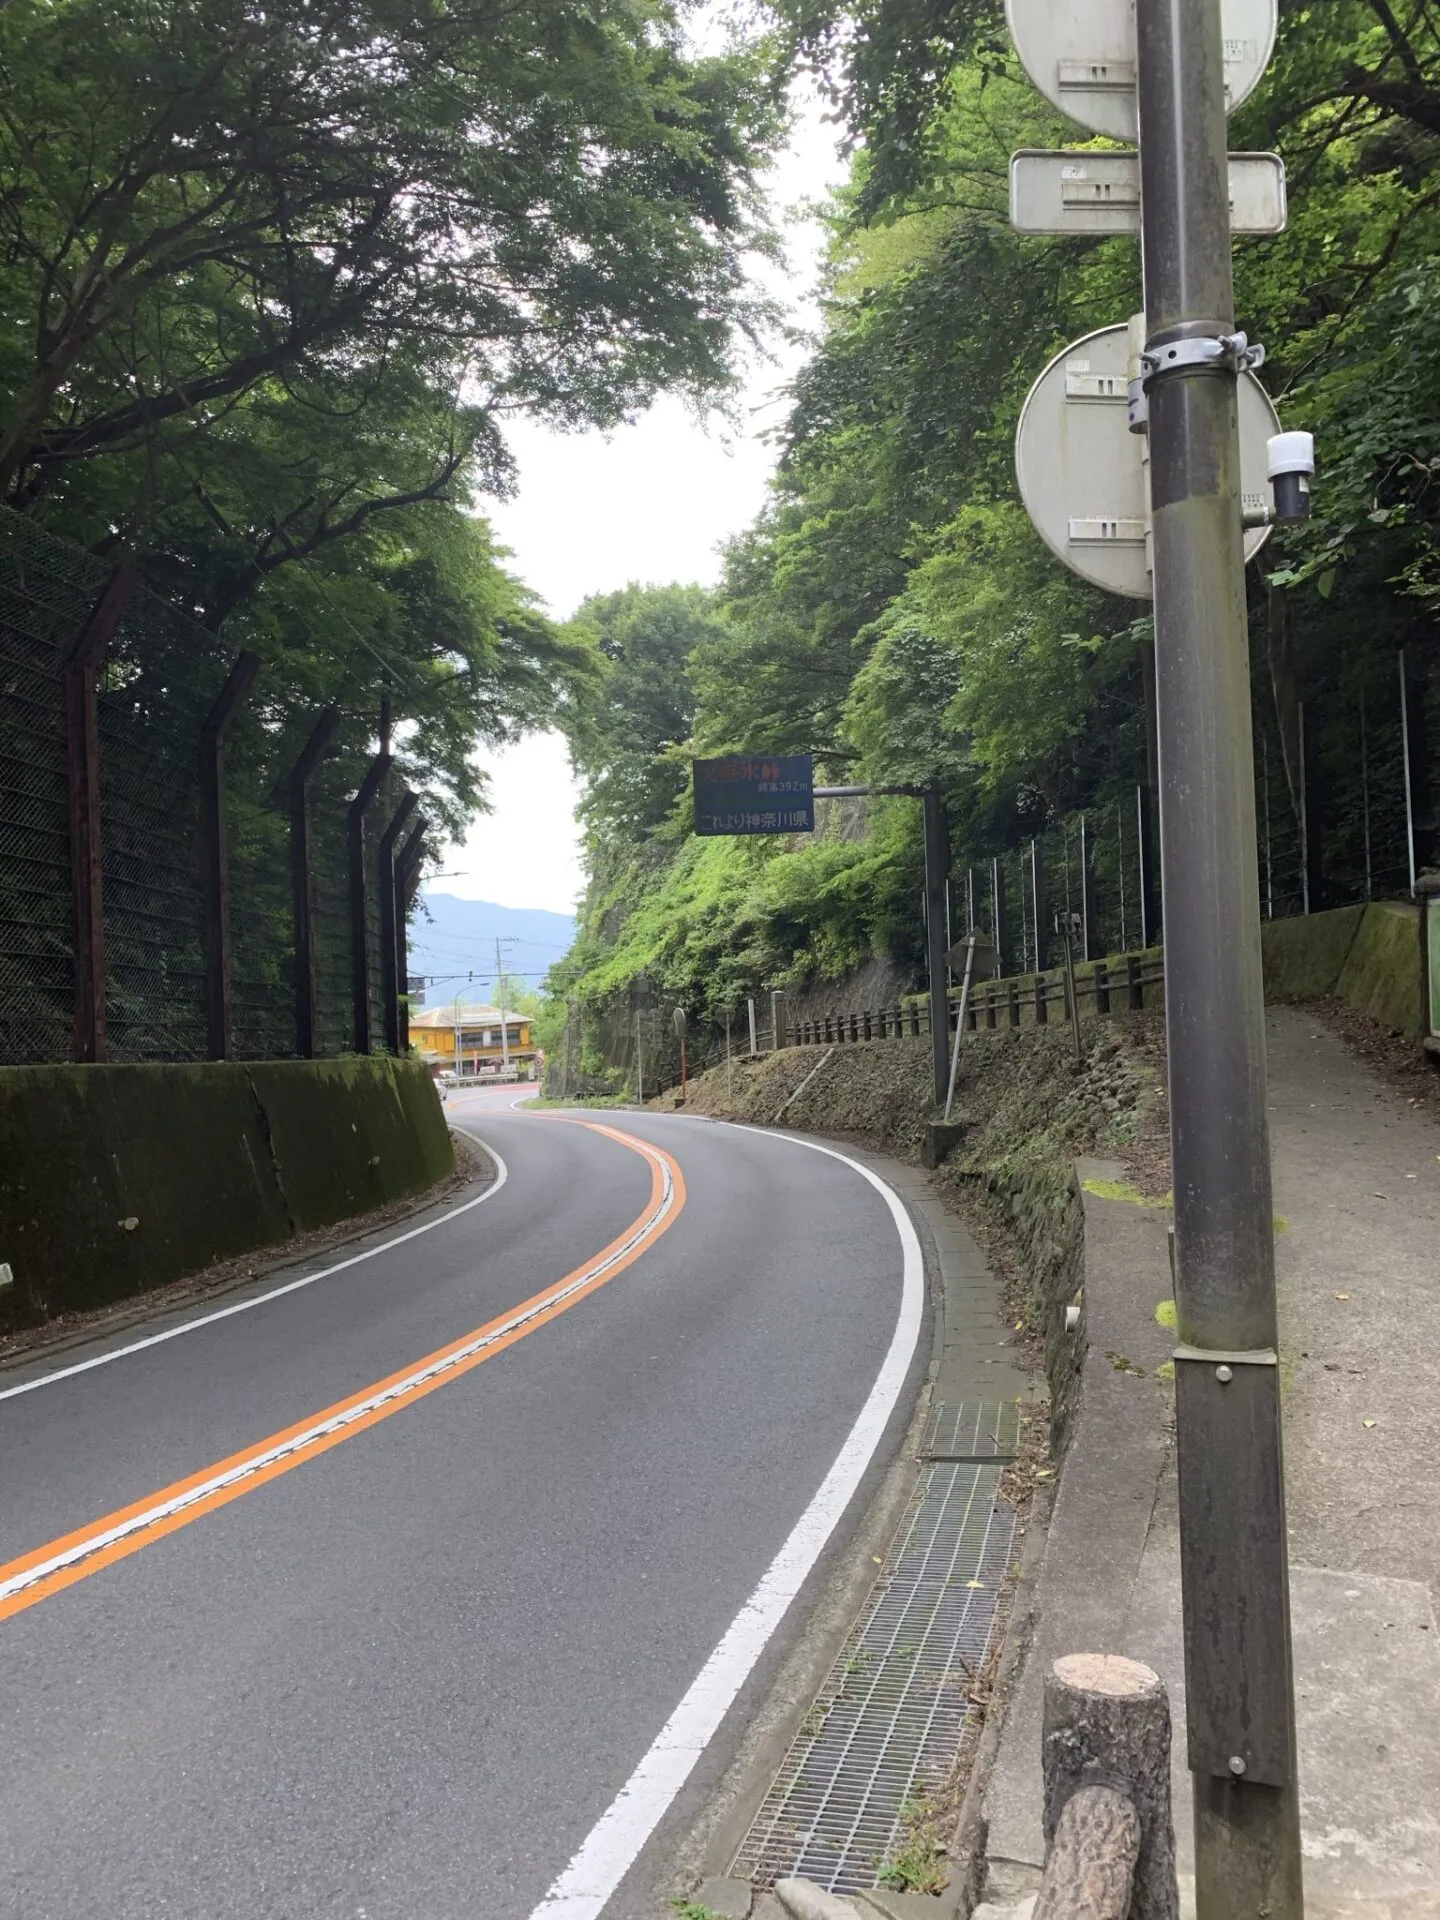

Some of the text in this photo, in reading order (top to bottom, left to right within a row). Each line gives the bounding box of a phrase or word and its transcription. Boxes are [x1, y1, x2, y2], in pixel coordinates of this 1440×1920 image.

[700, 810, 809, 831] これより神奈川県
